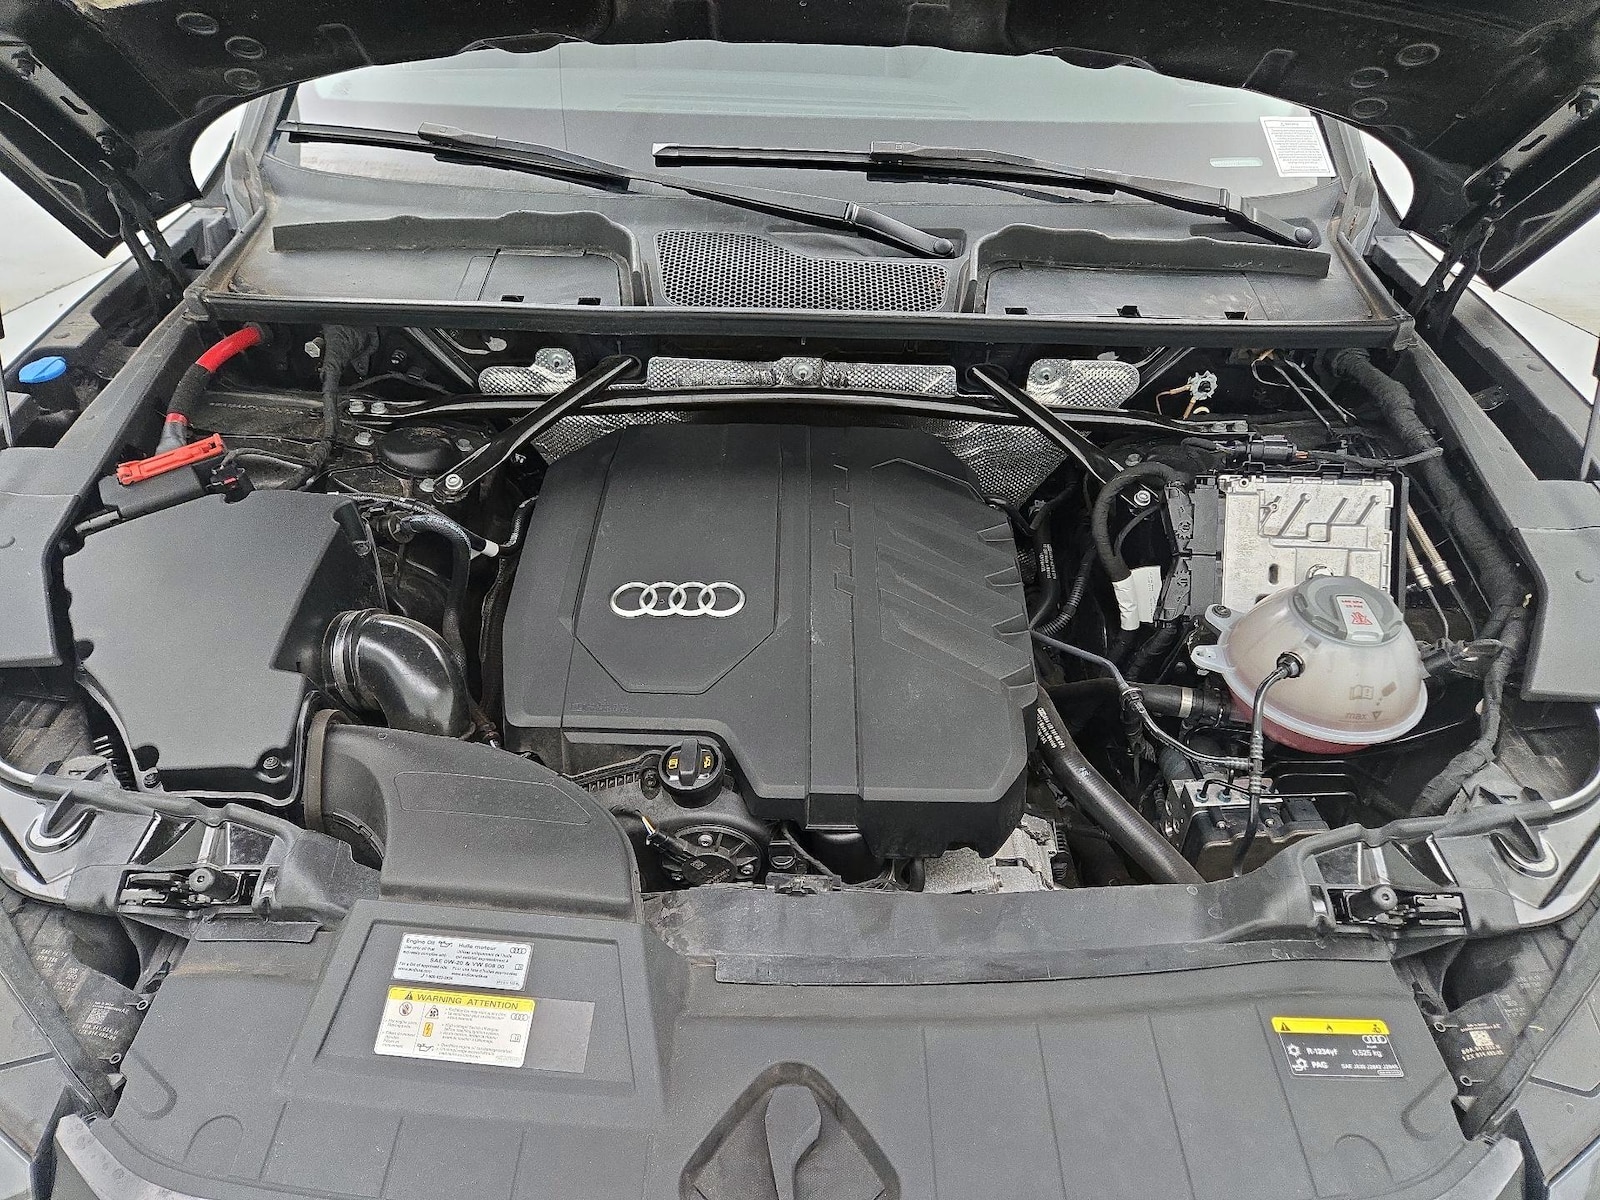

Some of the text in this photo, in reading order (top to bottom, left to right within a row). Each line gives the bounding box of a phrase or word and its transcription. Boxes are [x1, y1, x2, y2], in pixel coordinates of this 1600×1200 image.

[1345, 711, 1368, 720] max
[406, 937, 426, 945] Engine
[417, 993, 519, 1010] WARNING ATTENTION
[1306, 1047, 1338, 1057] R-1234yf
[1372, 1050, 1383, 1058] kg
[1311, 1061, 1328, 1069] PAG
